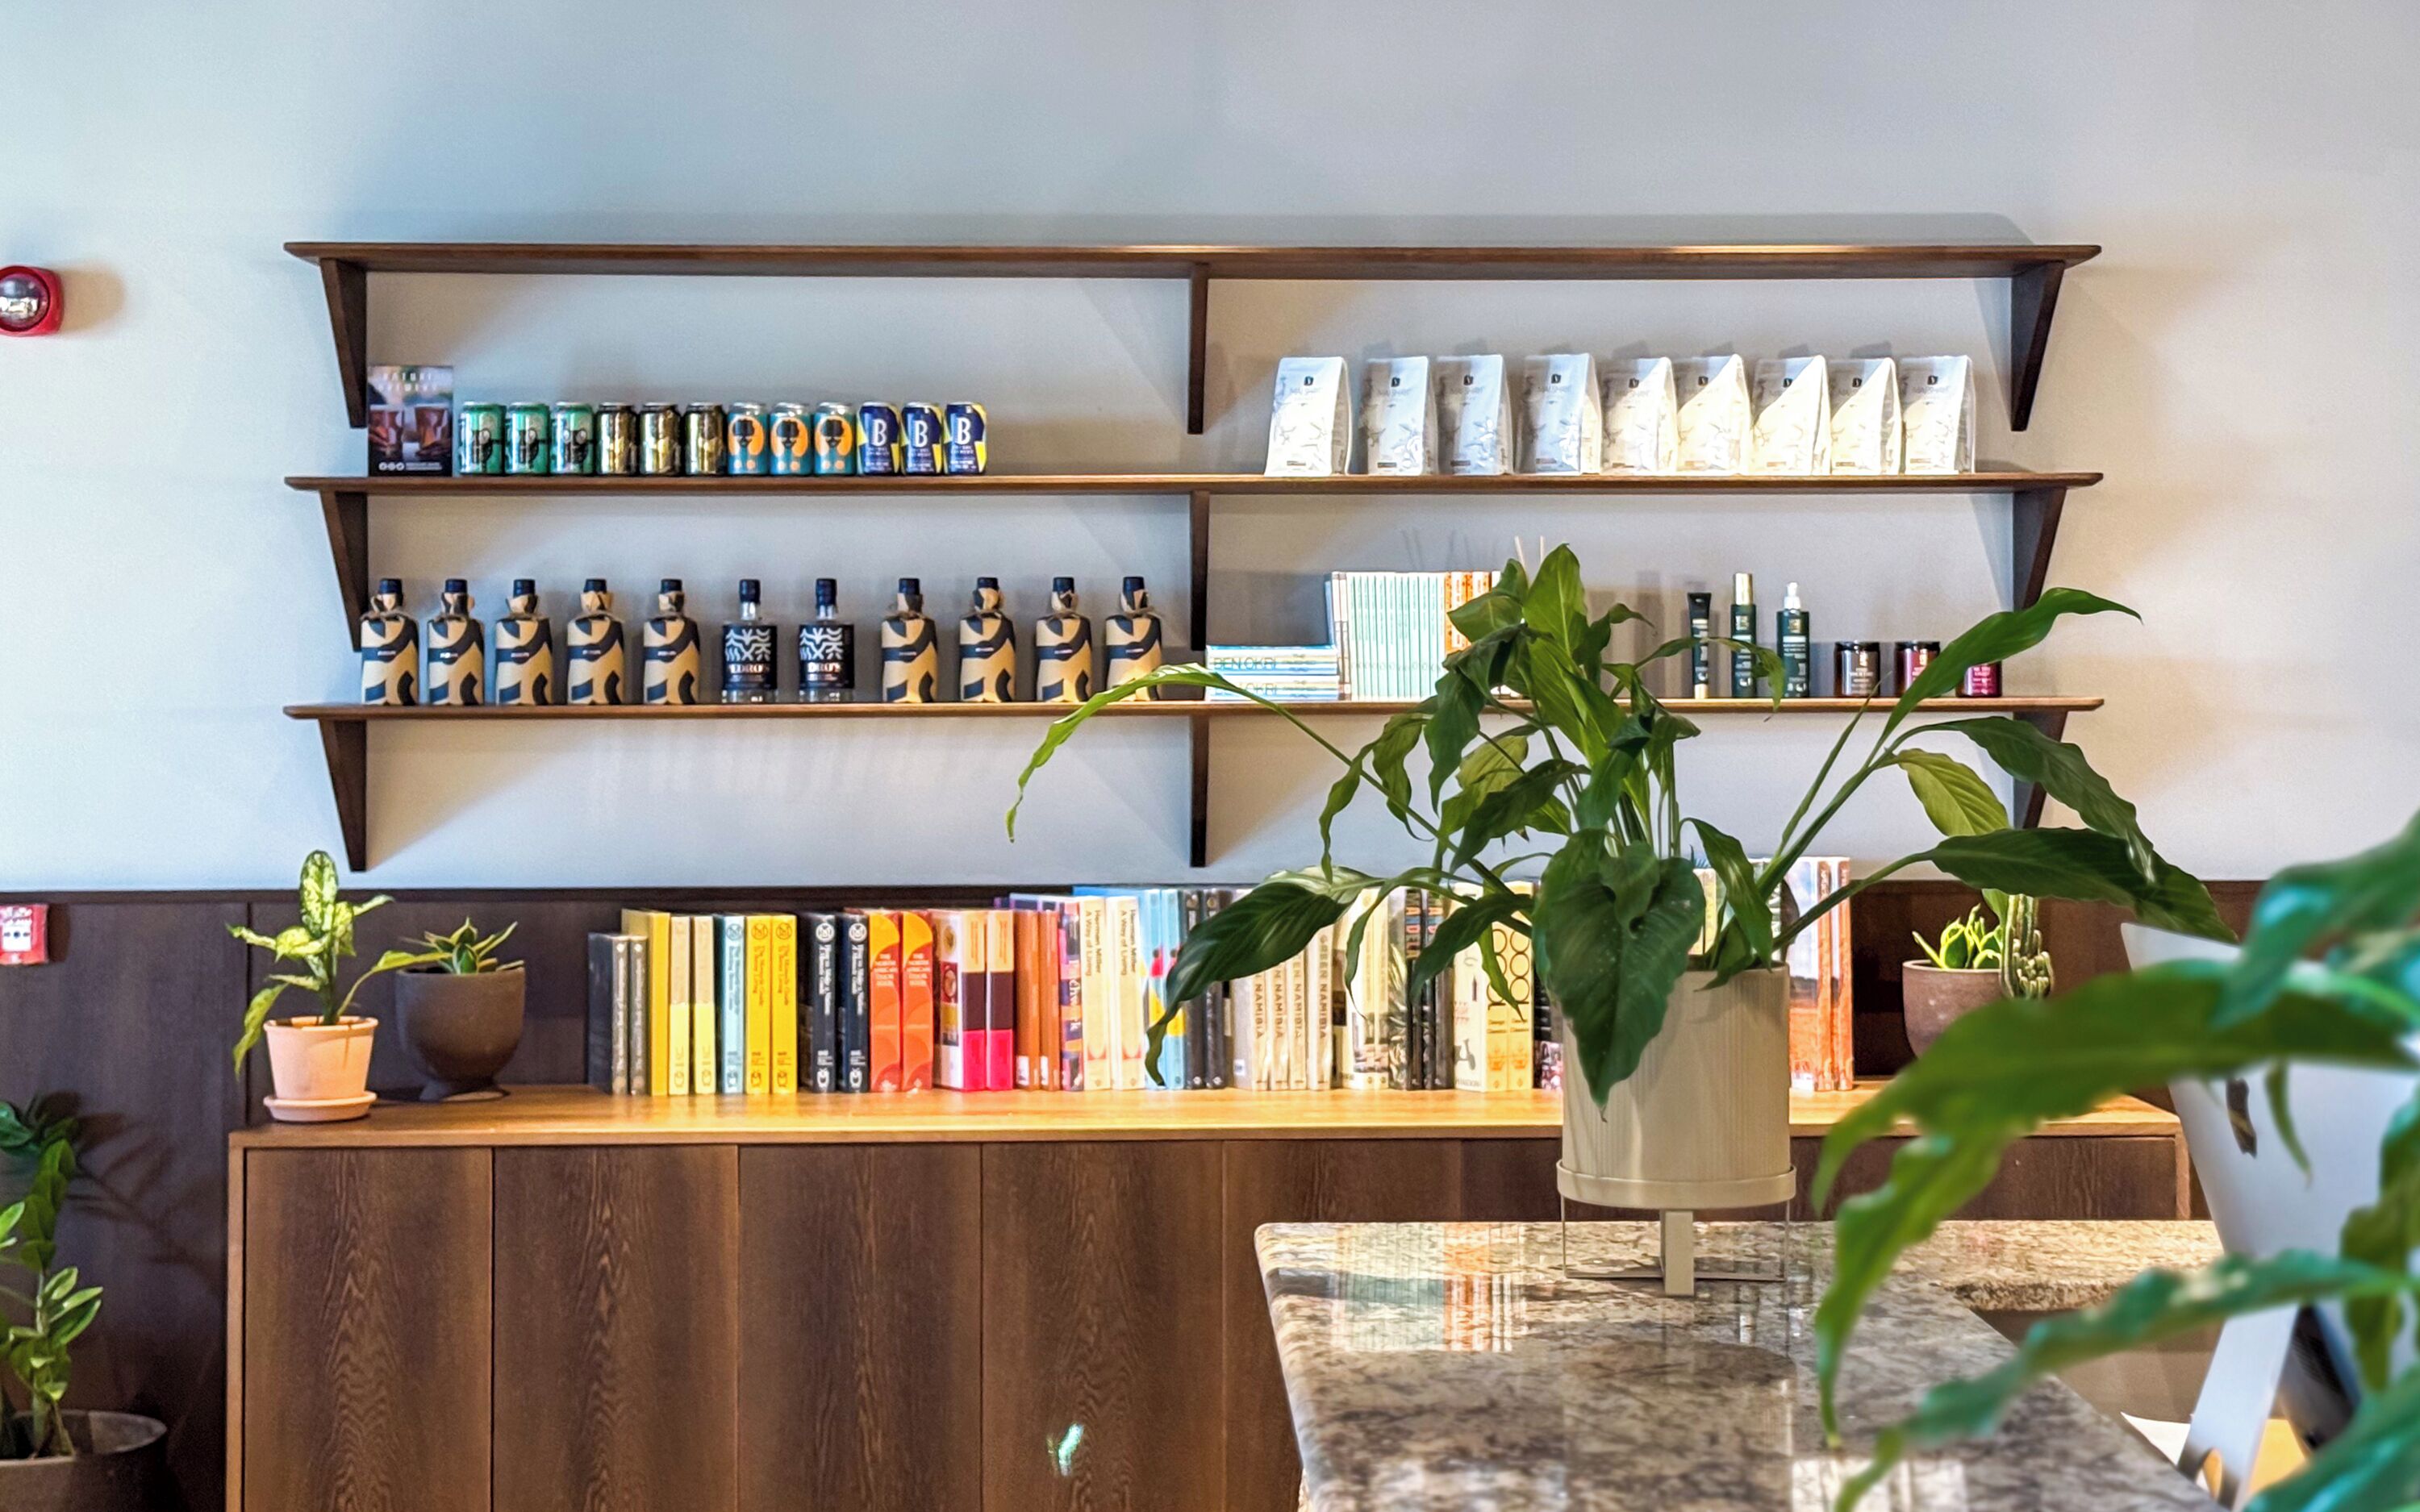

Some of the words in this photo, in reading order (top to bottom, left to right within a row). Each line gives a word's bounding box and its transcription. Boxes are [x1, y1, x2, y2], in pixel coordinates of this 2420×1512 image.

[873, 419, 887, 446] B
[914, 420, 928, 448] B
[957, 417, 972, 445] B
[1244, 657, 1277, 670] OKRI
[1085, 951, 1093, 976] Living
[1120, 950, 1129, 976] Living
[1320, 935, 1328, 978] GREEN
[1254, 984, 1263, 1039] NAMIBIA
[1275, 984, 1283, 1039] NAMIBIA
[1294, 984, 1302, 1039] NAMIBIA
[1320, 983, 1328, 1039] NAMIBIA
